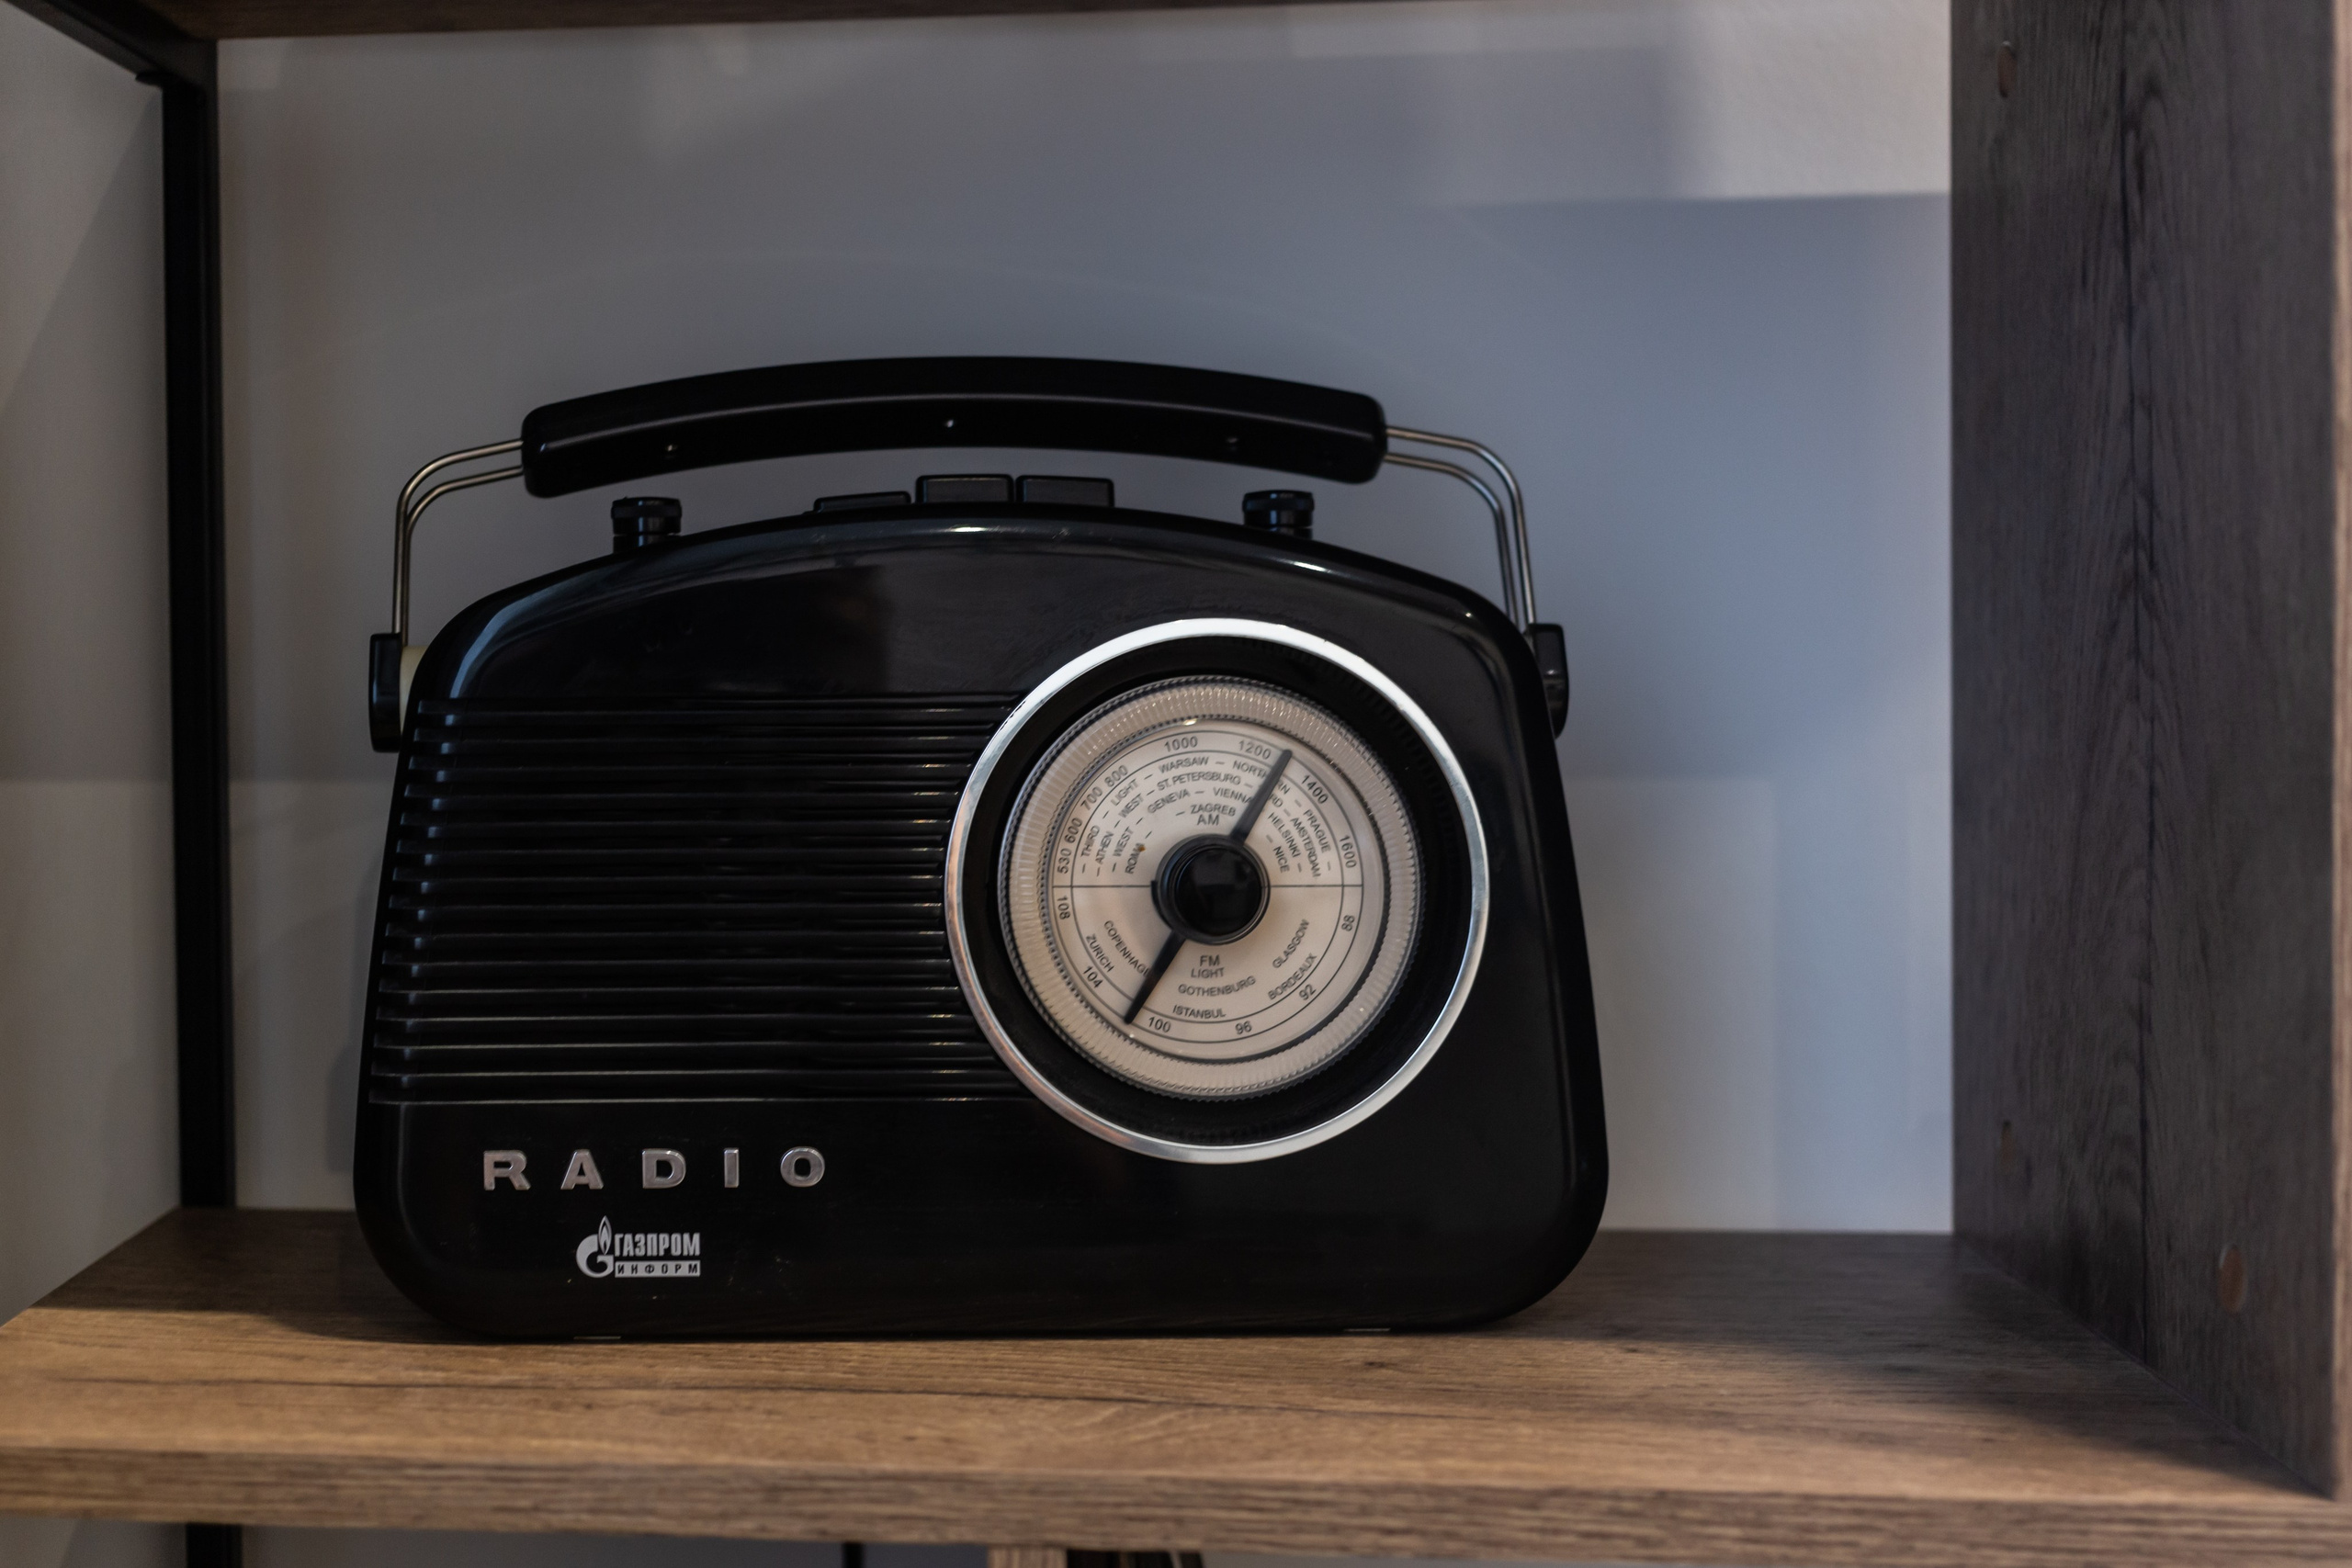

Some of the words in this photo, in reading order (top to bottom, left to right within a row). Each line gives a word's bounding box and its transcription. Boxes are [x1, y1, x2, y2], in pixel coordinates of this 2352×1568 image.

[1164, 736, 1198, 752] 1000
[1238, 740, 1272, 761] 1200
[1104, 764, 1128, 787] 800
[1159, 756, 1209, 773] WARSAW
[1232, 760, 1291, 795] NORTRN
[1080, 786, 1102, 811] 700
[1110, 779, 1138, 807] LIGHT
[1147, 788, 1191, 814] GENEVA
[1301, 774, 1329, 805] 1400
[1118, 793, 1145, 818] WEST
[1190, 803, 1236, 817] ZAGREB
[1065, 818, 1083, 844] 600
[1197, 815, 1219, 826] AM
[1303, 809, 1331, 853] PRAGUE
[1081, 825, 1101, 857] THIRD
[1095, 830, 1114, 865] ATHEN
[1113, 828, 1134, 857] WEST
[1267, 812, 1301, 858] HELSINKI
[1291, 818, 1321, 878] AMSTERDAM
[1057, 848, 1072, 874] 530
[1272, 846, 1290, 874] NICE
[1339, 835, 1357, 869] 1600
[1057, 895, 1070, 920] 108
[1341, 914, 1355, 932] 88
[1086, 933, 1114, 973] ZURICH
[1103, 919, 1150, 977] COPENHAG
[1272, 919, 1310, 969] GLASGOW
[1191, 967, 1225, 979] LIGHT
[1199, 954, 1220, 966] FM
[1082, 965, 1102, 989] 104
[1178, 975, 1257, 998] GOTHENBURG
[1267, 953, 1317, 1000] BORDEAUX
[1298, 983, 1317, 1001] 92
[1148, 1016, 1171, 1033] 100
[1171, 1004, 1227, 1020] ISTANBUL
[1235, 1020, 1253, 1035] 96
[482, 1145, 826, 1191] RADIO
[614, 1232, 701, 1258] ГАЗПРОМ
[616, 1263, 698, 1275] ИНФОРМ
